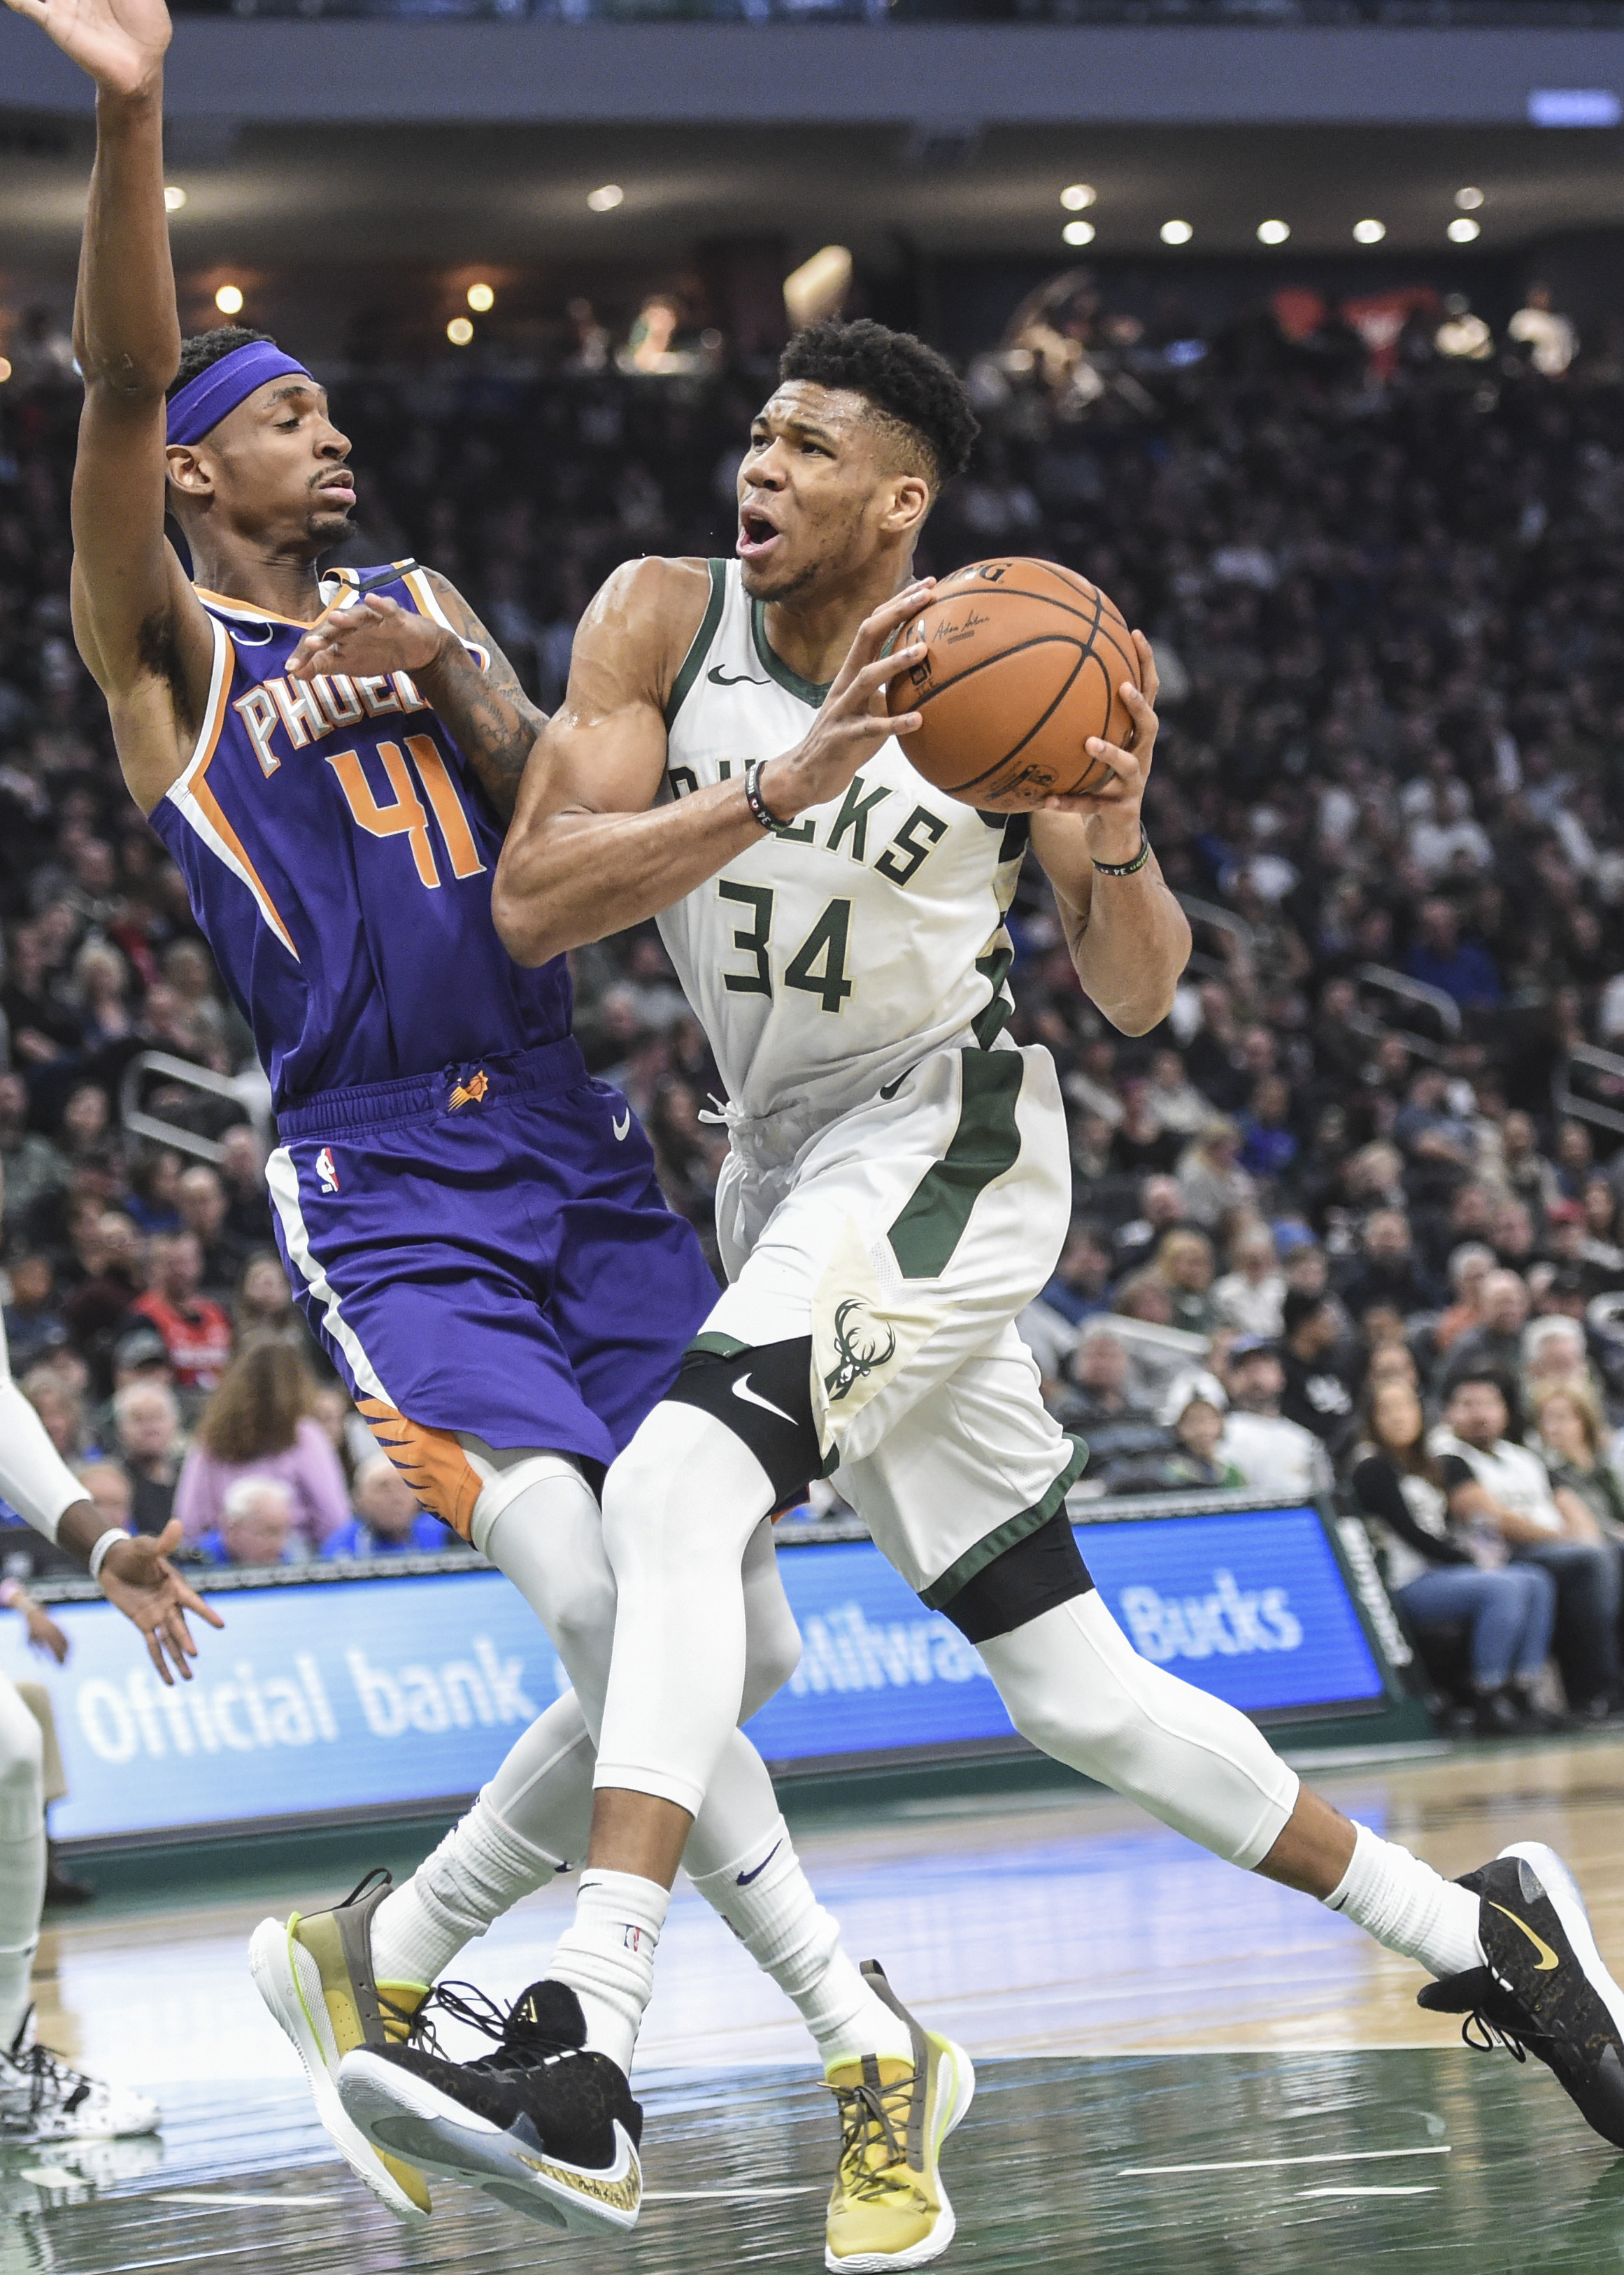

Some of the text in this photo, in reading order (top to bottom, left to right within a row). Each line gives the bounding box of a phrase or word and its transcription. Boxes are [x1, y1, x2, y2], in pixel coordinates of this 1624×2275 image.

[325, 734, 487, 889] 41
[716, 878, 855, 1014] 34
[76, 1652, 339, 1764] Official
[346, 1636, 539, 1739] bank
[789, 1600, 990, 1698] Milwa
[1120, 1567, 1304, 1662] Bucks
